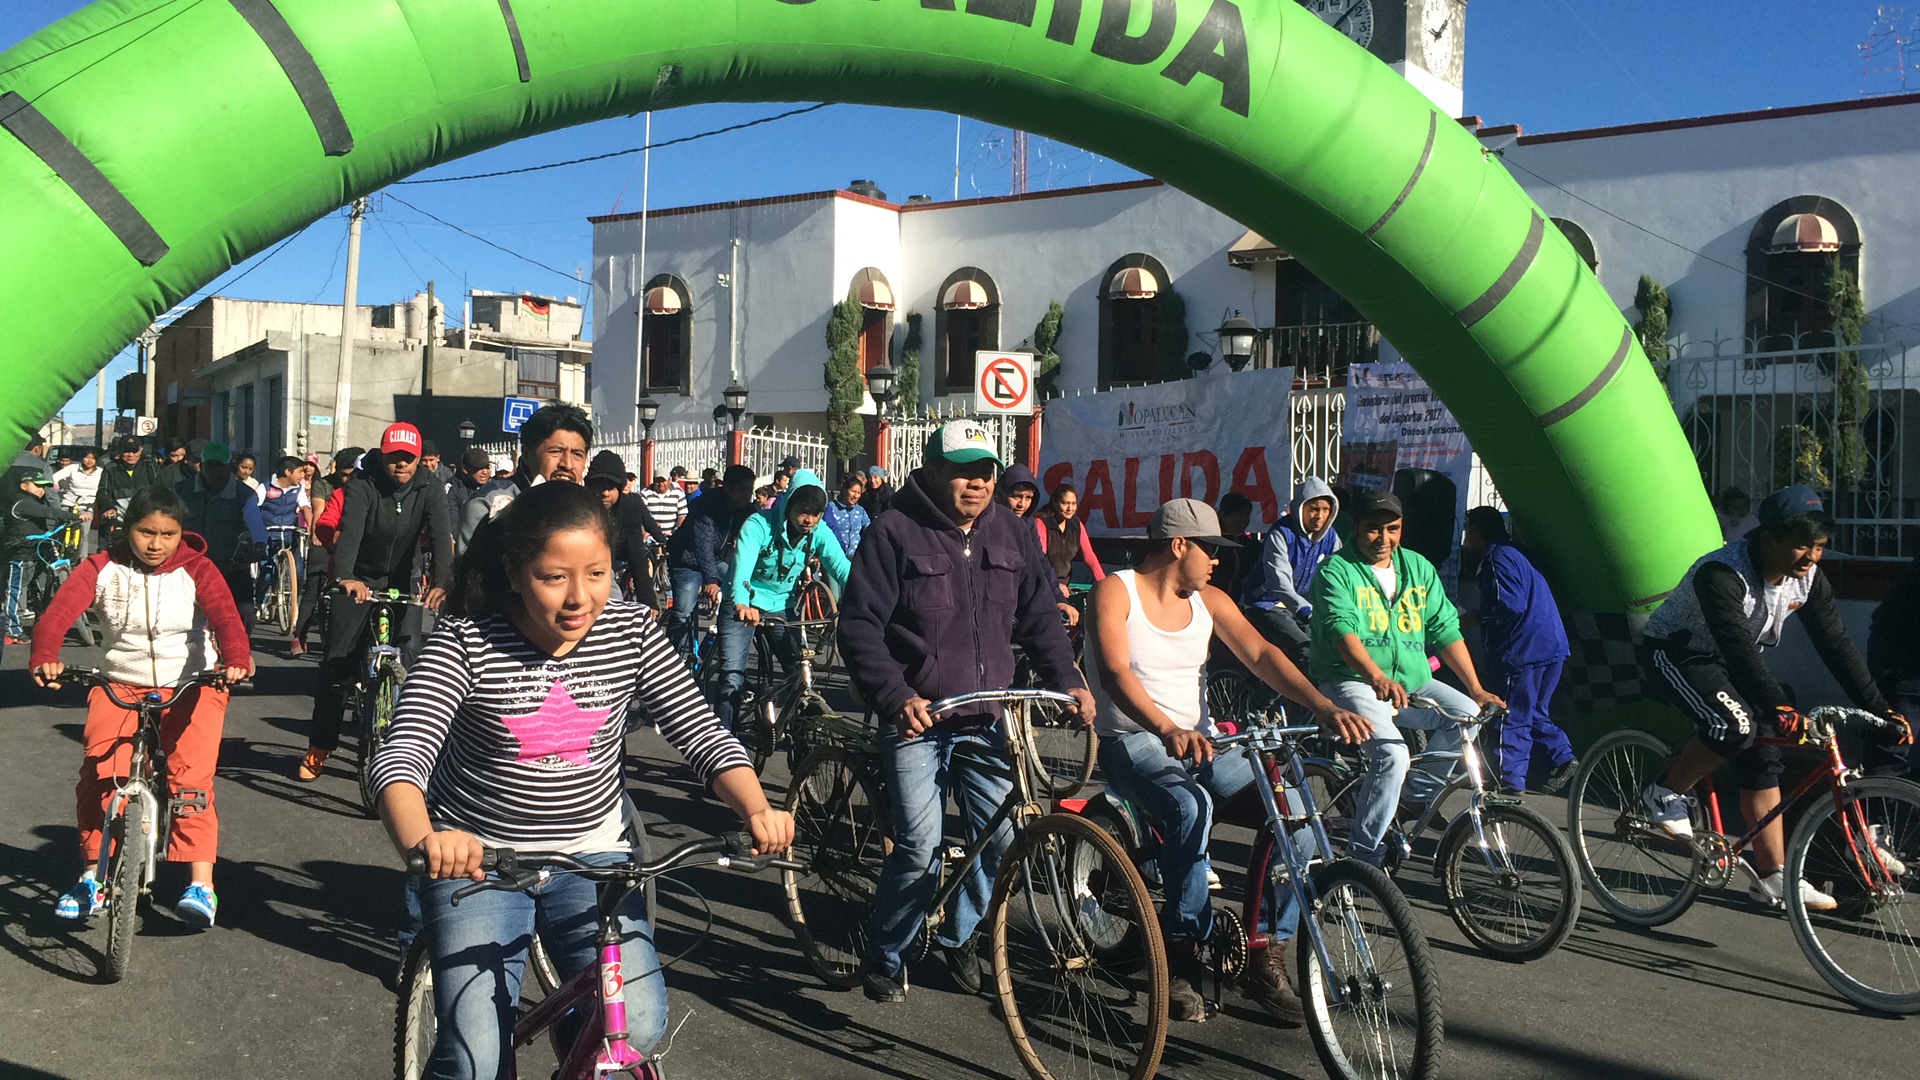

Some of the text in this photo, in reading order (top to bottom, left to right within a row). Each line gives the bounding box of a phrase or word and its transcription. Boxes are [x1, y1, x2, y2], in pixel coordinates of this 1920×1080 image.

[1402, 391, 1429, 407] premio
[1379, 412, 1391, 424] del
[965, 428, 987, 440] CAT
[1401, 427, 1425, 437] Datos
[1043, 446, 1278, 528] SALIDA
[1368, 609, 1422, 634] 1969
[1716, 691, 1751, 735] adidas
